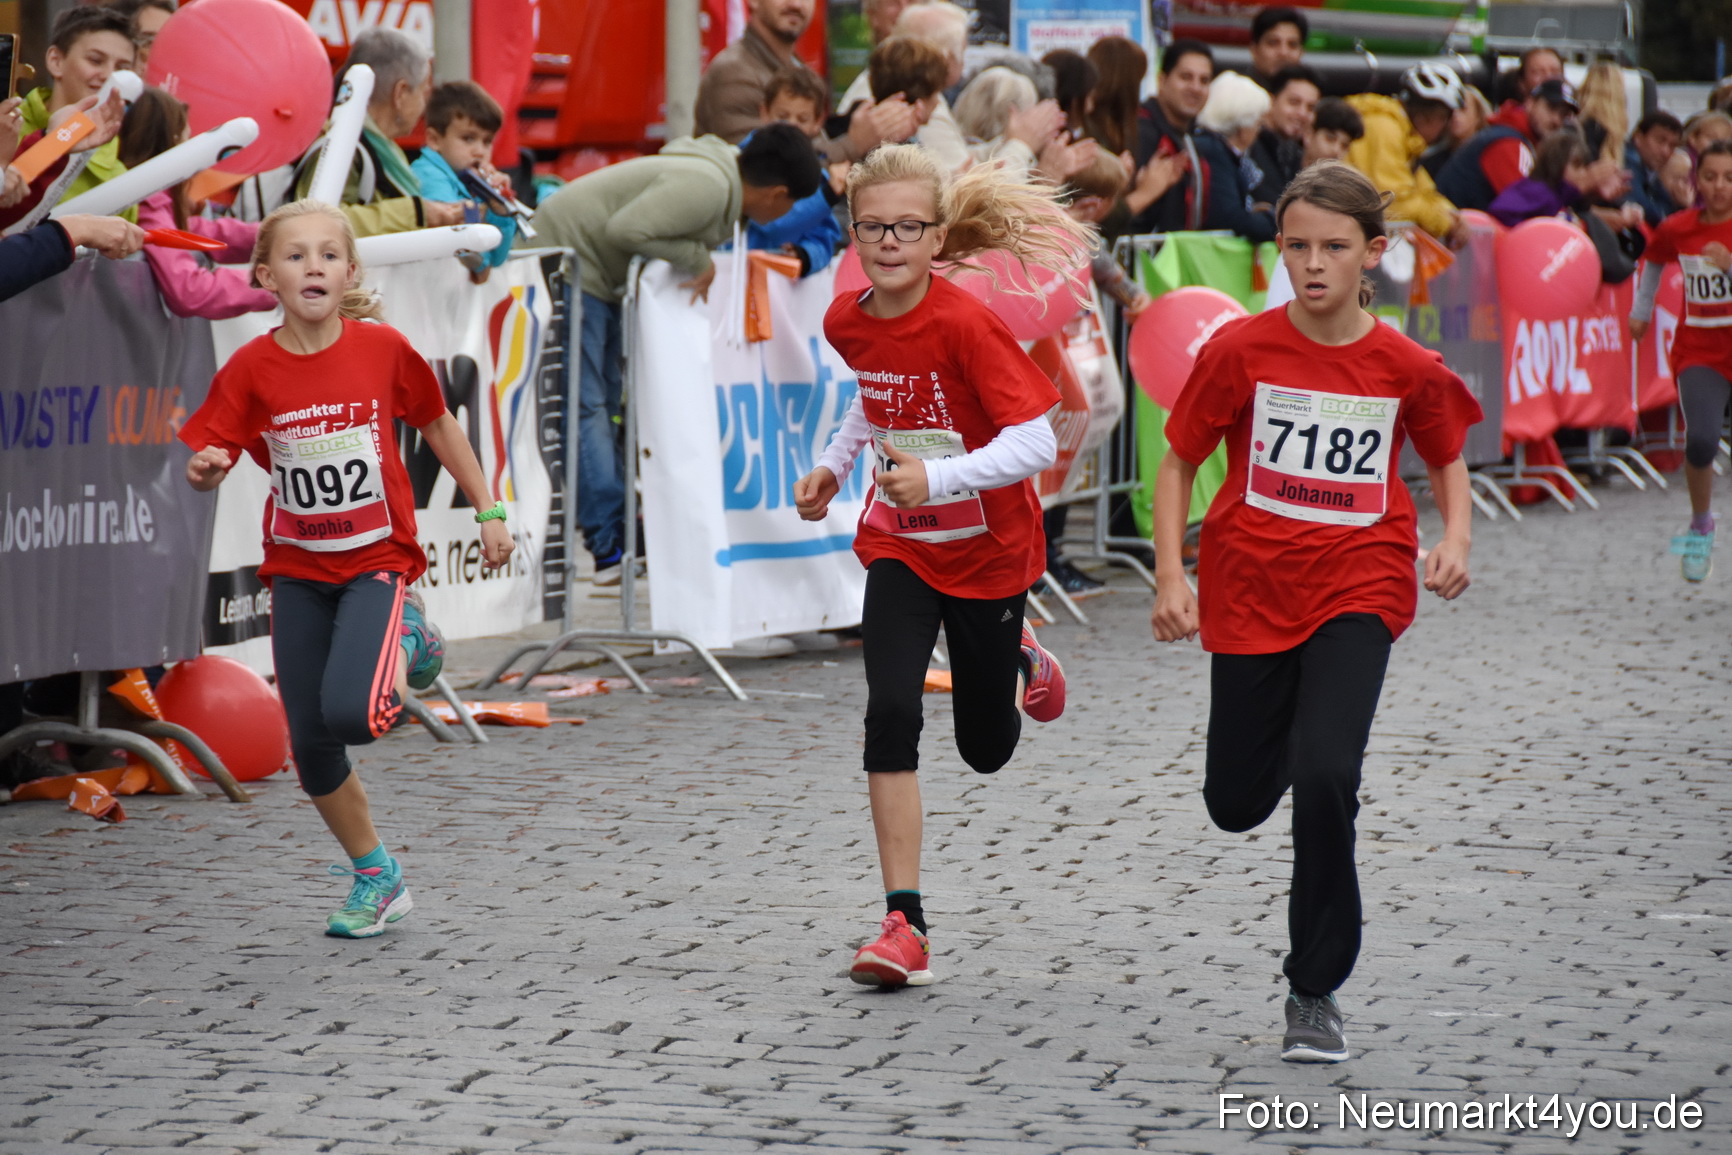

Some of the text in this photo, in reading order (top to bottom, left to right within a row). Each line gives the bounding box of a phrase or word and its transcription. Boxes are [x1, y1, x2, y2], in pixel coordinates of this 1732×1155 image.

[305, 0, 434, 54] AVIA
[1686, 273, 1732, 299] 703
[855, 369, 906, 385] eumarkter
[1266, 399, 1312, 413] NeuerMarkt
[1320, 397, 1388, 417] BOCK
[297, 432, 363, 456] BOCK
[893, 433, 953, 448] BOCK
[1267, 417, 1382, 475] 7182
[275, 458, 373, 509] 7092
[1276, 480, 1355, 507] Johanna
[296, 518, 354, 539] Sophia
[897, 513, 938, 530] Lena
